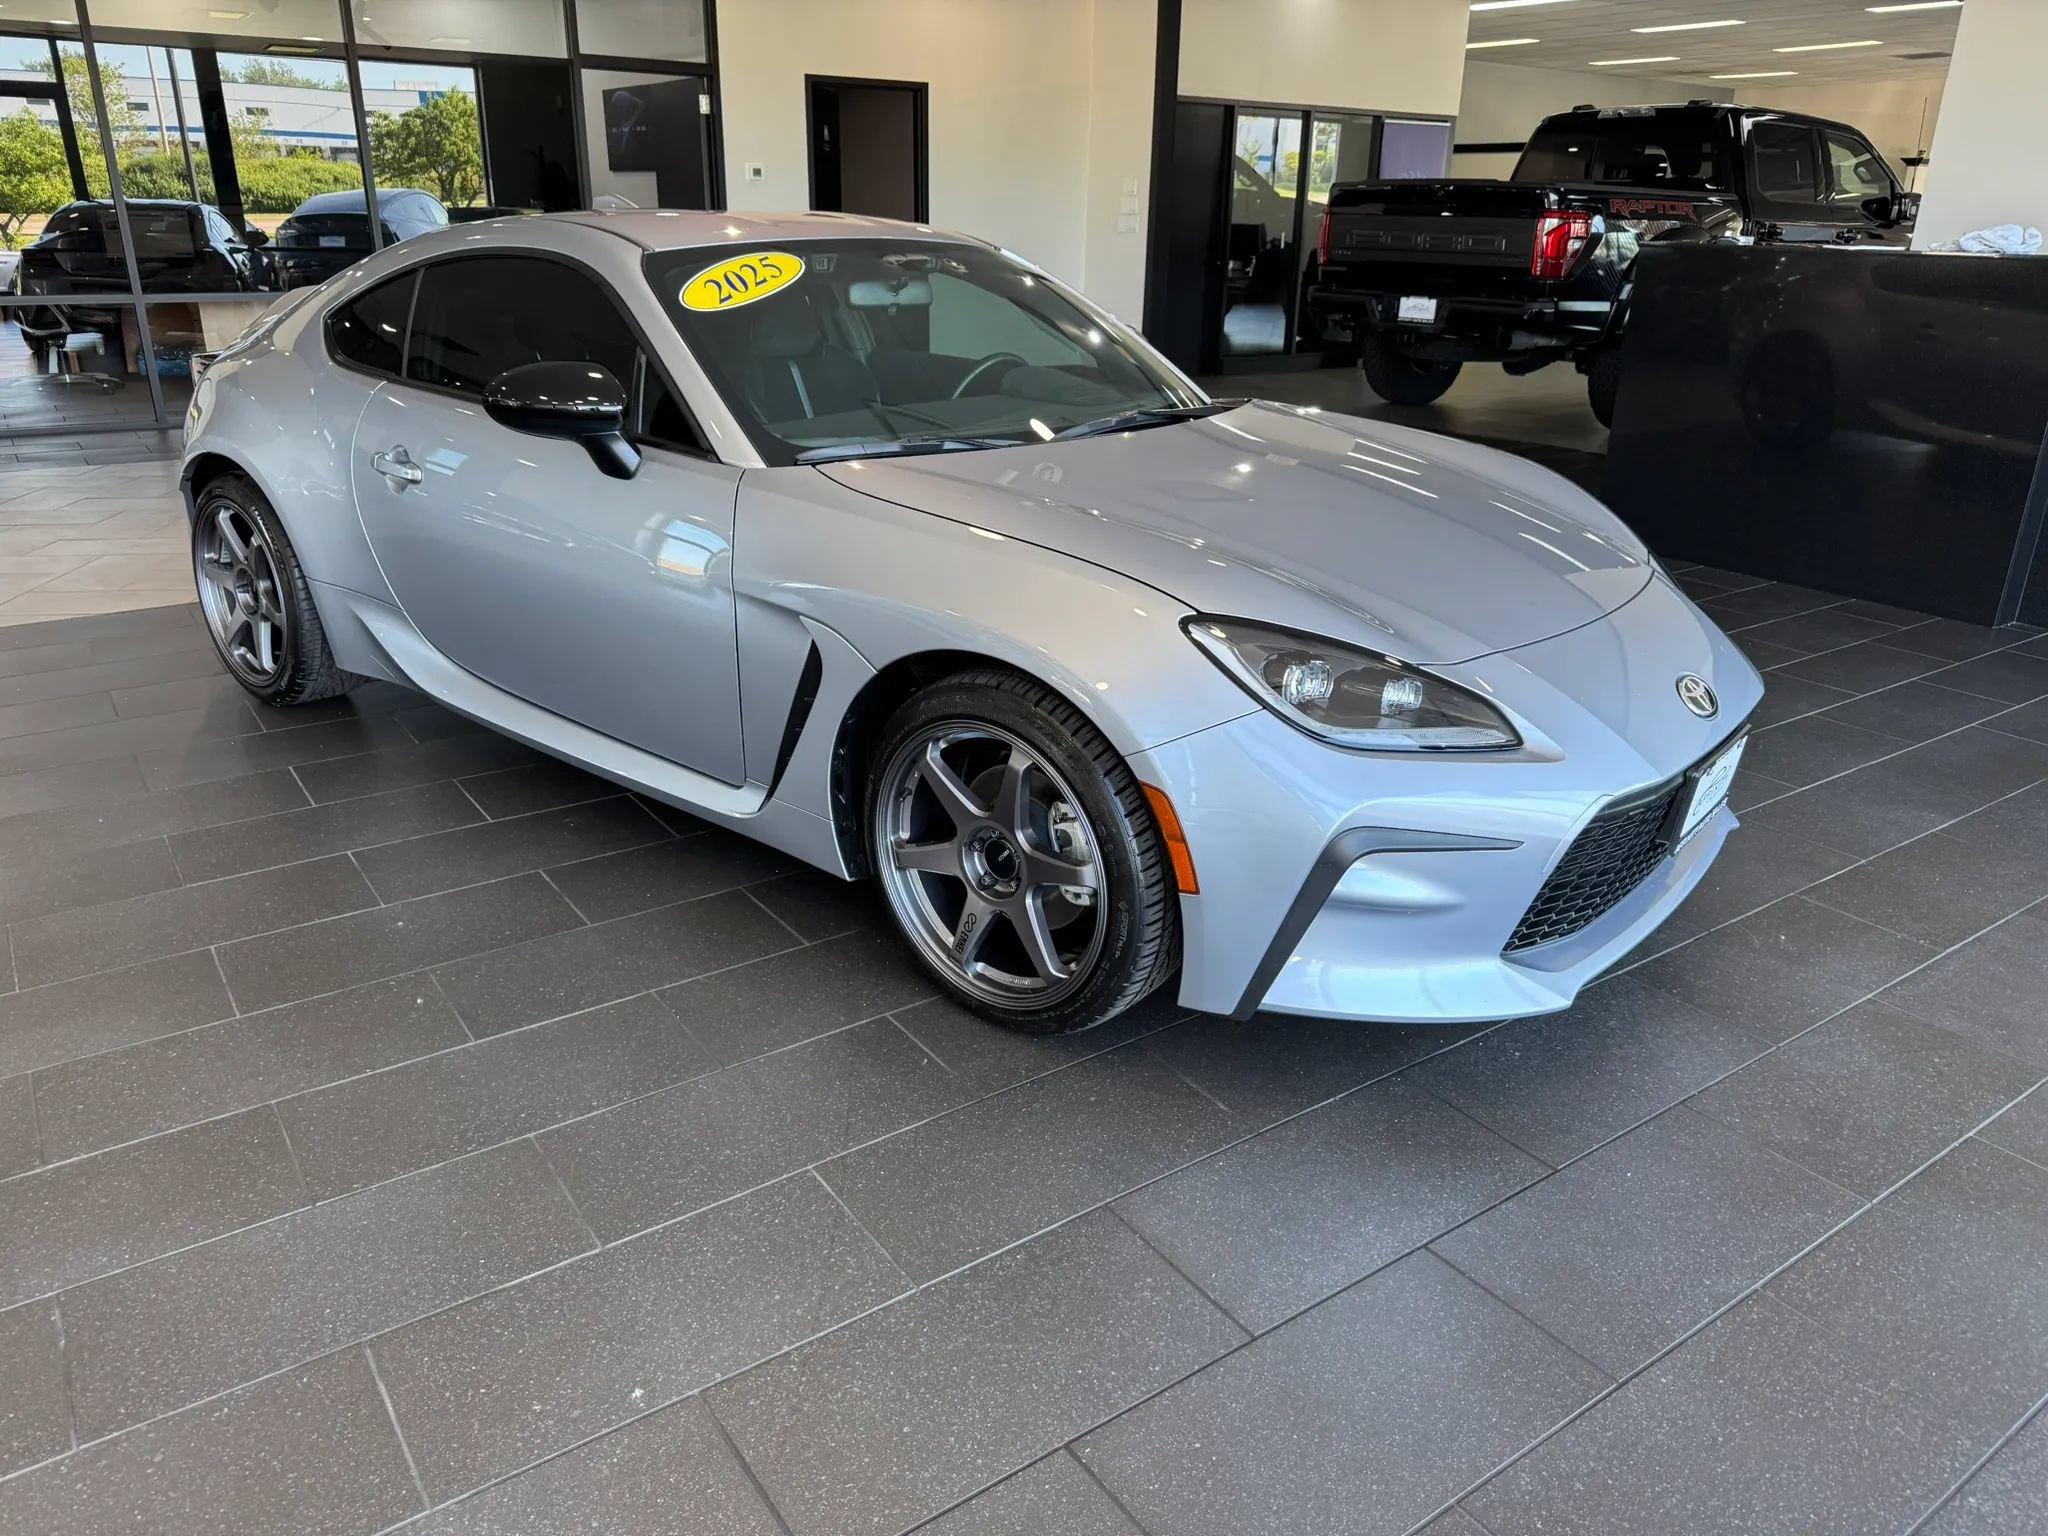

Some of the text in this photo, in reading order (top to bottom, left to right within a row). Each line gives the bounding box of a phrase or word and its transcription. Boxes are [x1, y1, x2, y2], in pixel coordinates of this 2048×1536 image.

[1610, 198, 1698, 222] RAPTOR
[704, 256, 783, 305] 2025
[955, 931, 969, 955] ENKEI
